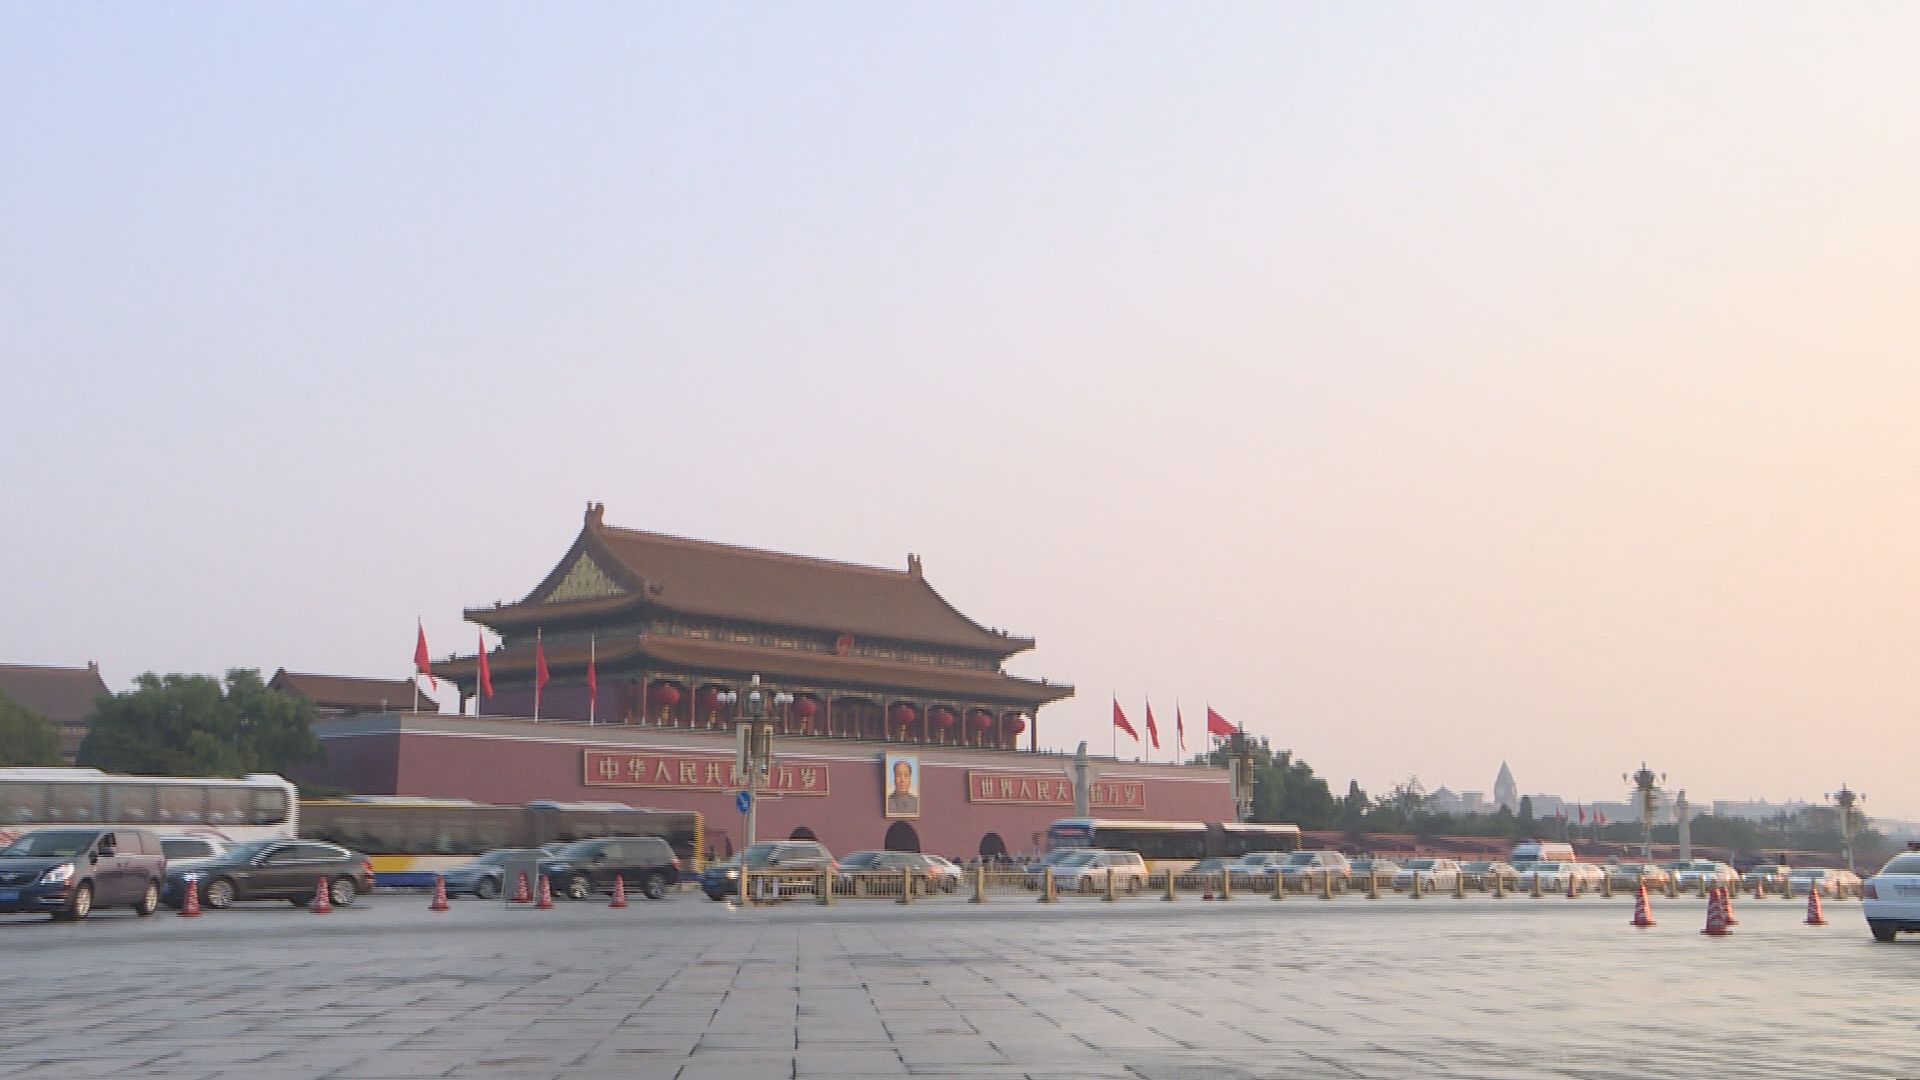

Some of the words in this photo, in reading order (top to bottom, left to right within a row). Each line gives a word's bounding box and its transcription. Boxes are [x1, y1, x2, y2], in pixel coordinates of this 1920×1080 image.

[980, 777, 1137, 804] 世界人民大结万岁
